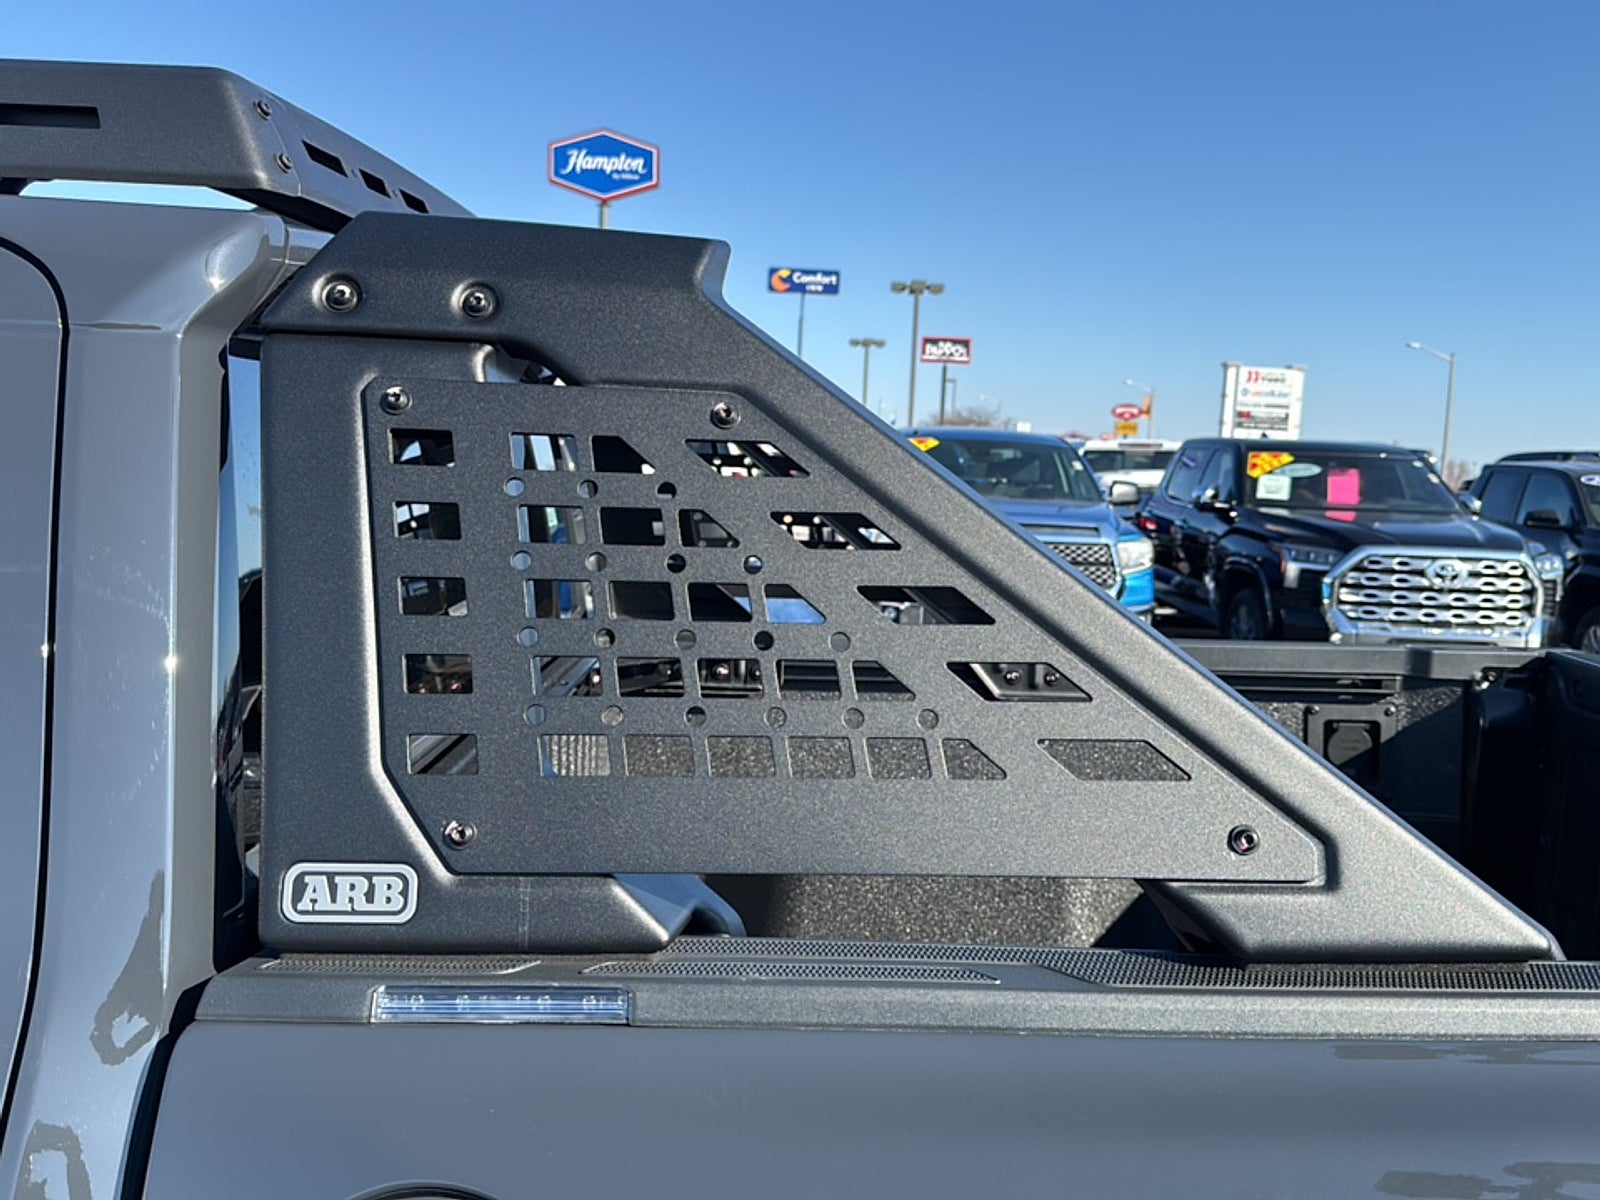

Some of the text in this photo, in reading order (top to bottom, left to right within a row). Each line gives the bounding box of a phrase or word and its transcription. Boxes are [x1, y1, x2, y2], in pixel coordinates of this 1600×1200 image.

[560, 147, 648, 175] Hampton
[792, 271, 837, 286] Comfort
[296, 875, 404, 912] ARB
